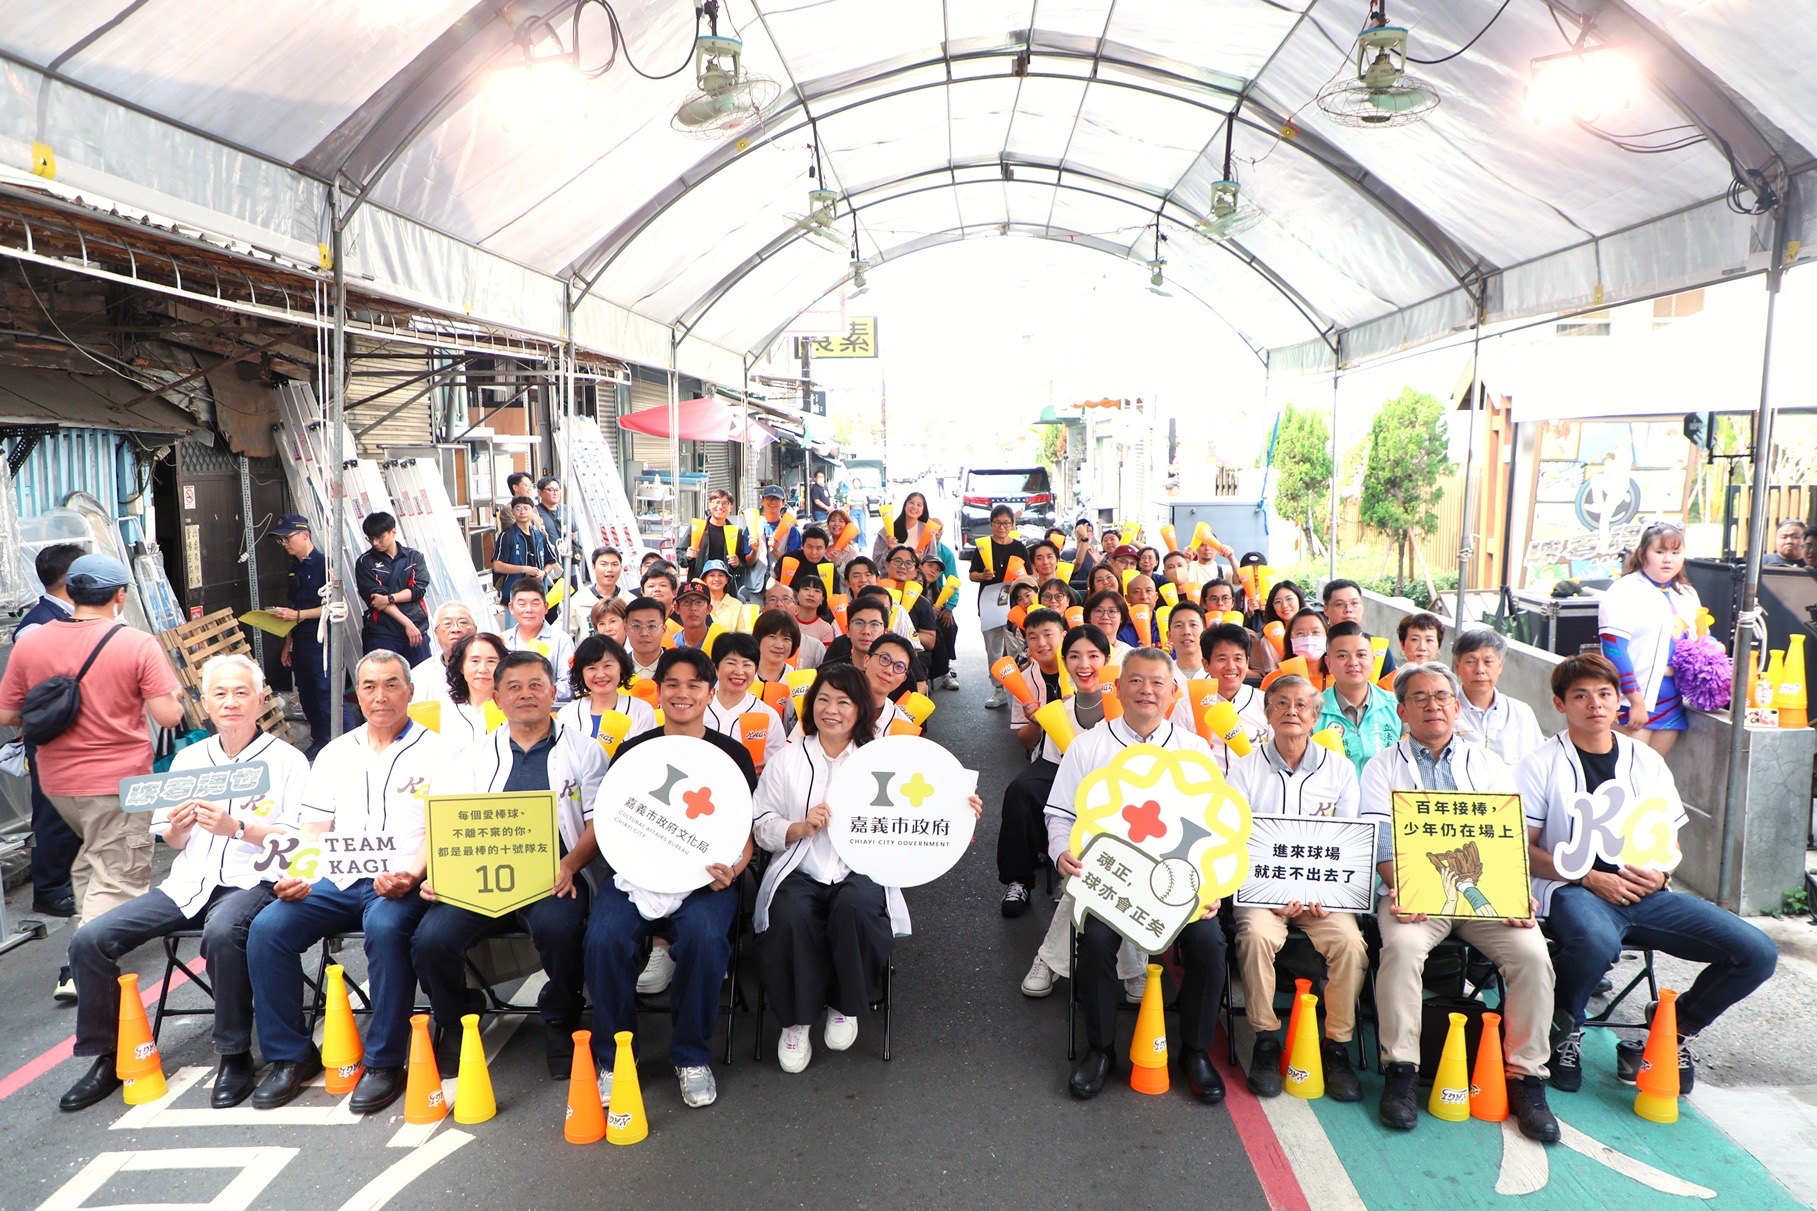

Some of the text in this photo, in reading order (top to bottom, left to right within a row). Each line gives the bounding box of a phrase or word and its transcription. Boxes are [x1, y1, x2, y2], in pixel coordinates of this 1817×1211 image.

[613, 817, 647, 839] CHIAYI CITY
[618, 809, 690, 855] CULTURAL AFFAIRS BUREAU
[624, 796, 710, 854] 嘉義市政府文化局
[850, 816, 950, 836] 嘉義市政府
[1403, 822, 1515, 839] 少年仍在場上
[1561, 785, 1674, 873] KG
[324, 836, 396, 852] TEAM
[437, 843, 548, 858] 都是最棒的十號隊友
[1272, 843, 1341, 861] 進來球場
[253, 837, 321, 880] KG
[328, 859, 390, 875] KAGI
[475, 864, 515, 894] 10
[1254, 864, 1355, 884] 就走不出去了
[1081, 871, 1166, 939] 球亦會正矣
